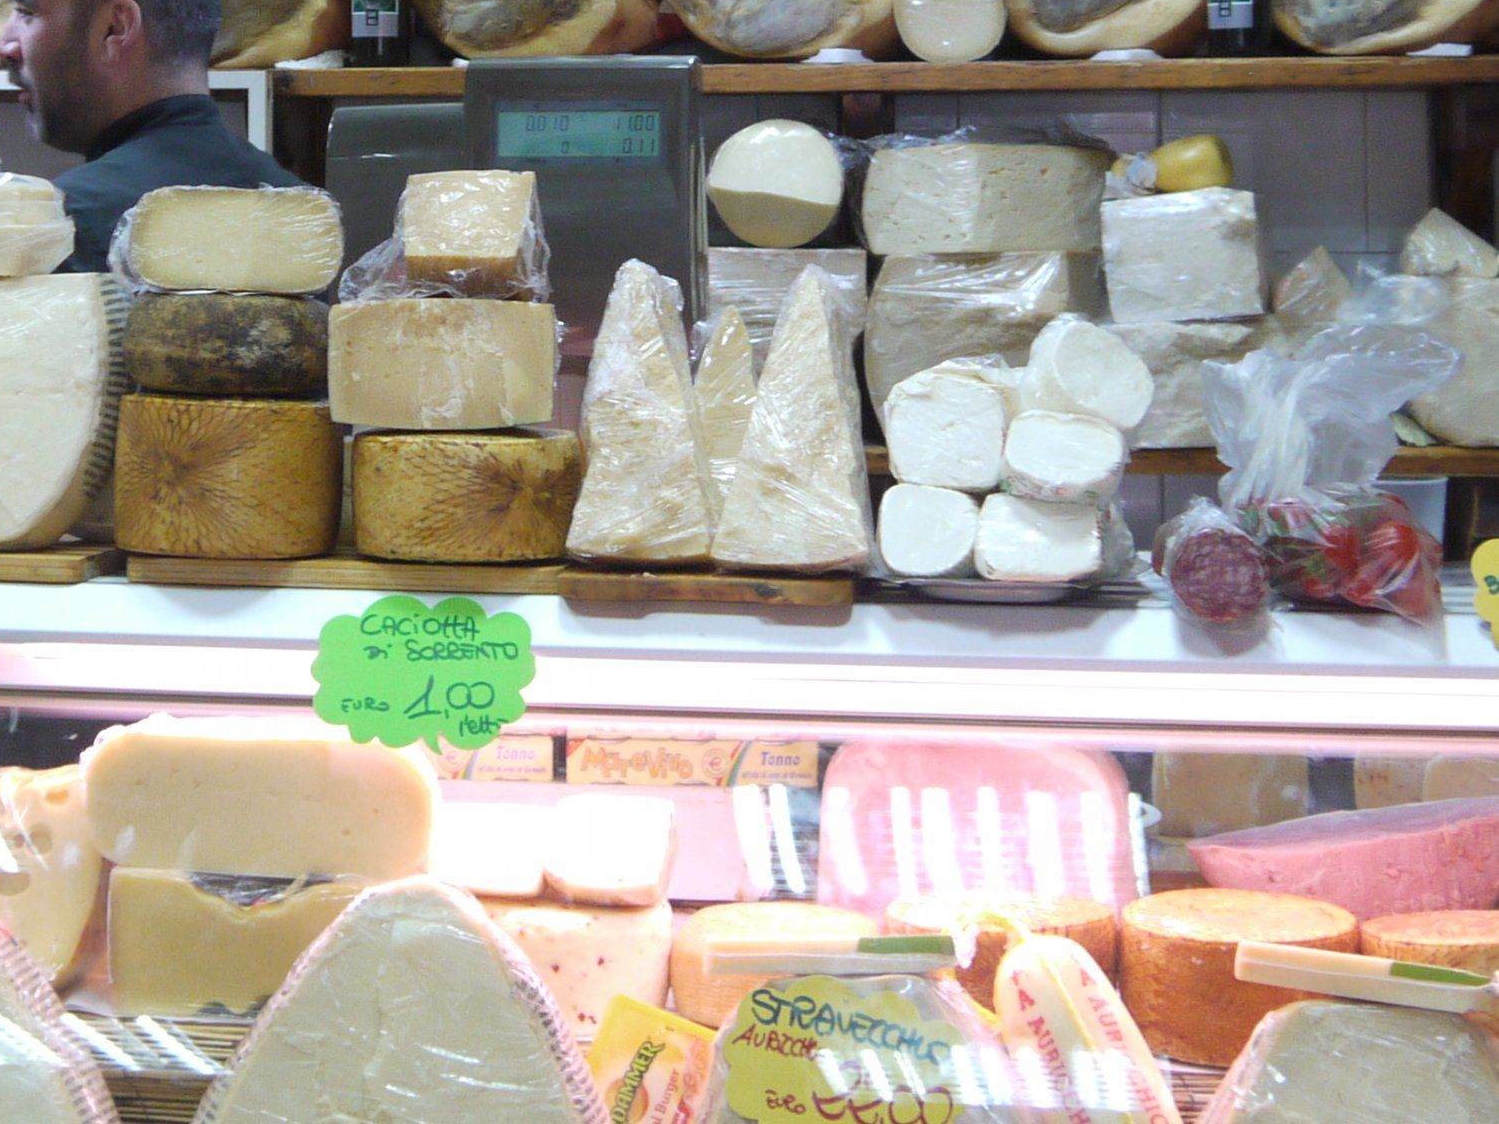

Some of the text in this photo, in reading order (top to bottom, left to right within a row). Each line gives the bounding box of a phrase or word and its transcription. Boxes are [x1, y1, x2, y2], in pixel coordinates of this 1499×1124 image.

[405, 639, 519, 662] SORRENTO
[340, 673, 495, 719] EURO 1,00
[495, 746, 536, 761] Tonno
[760, 750, 802, 767] Tonno
[654, 1067, 680, 1115] Burger
